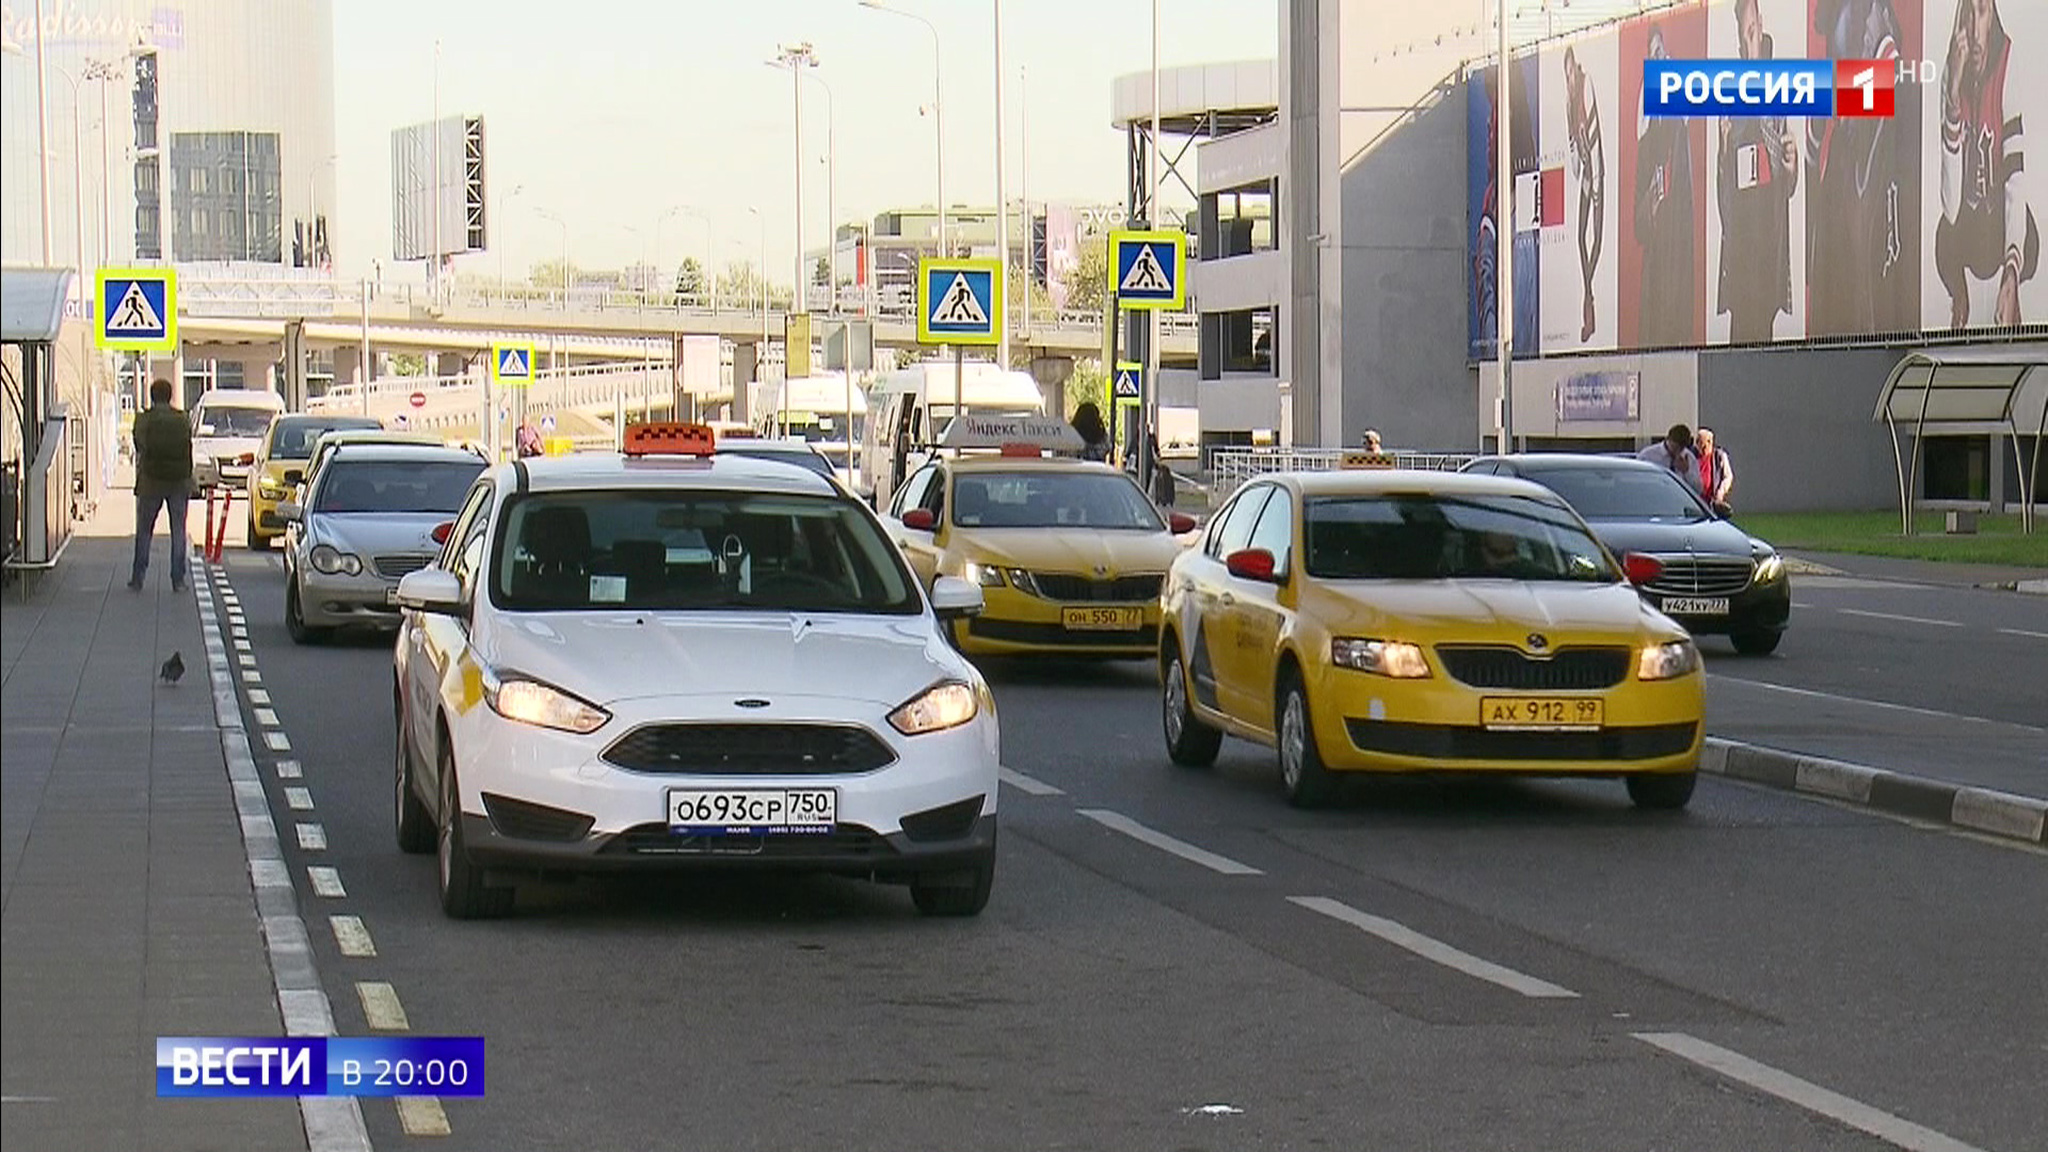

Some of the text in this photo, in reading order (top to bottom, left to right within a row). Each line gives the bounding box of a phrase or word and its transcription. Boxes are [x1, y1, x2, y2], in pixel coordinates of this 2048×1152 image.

[965, 418, 1063, 437] Яндекс Такси
[1092, 610, 1118, 623] 550
[1527, 702, 1564, 720] 912
[1576, 701, 1596, 715] 99
[788, 793, 828, 813] 750
